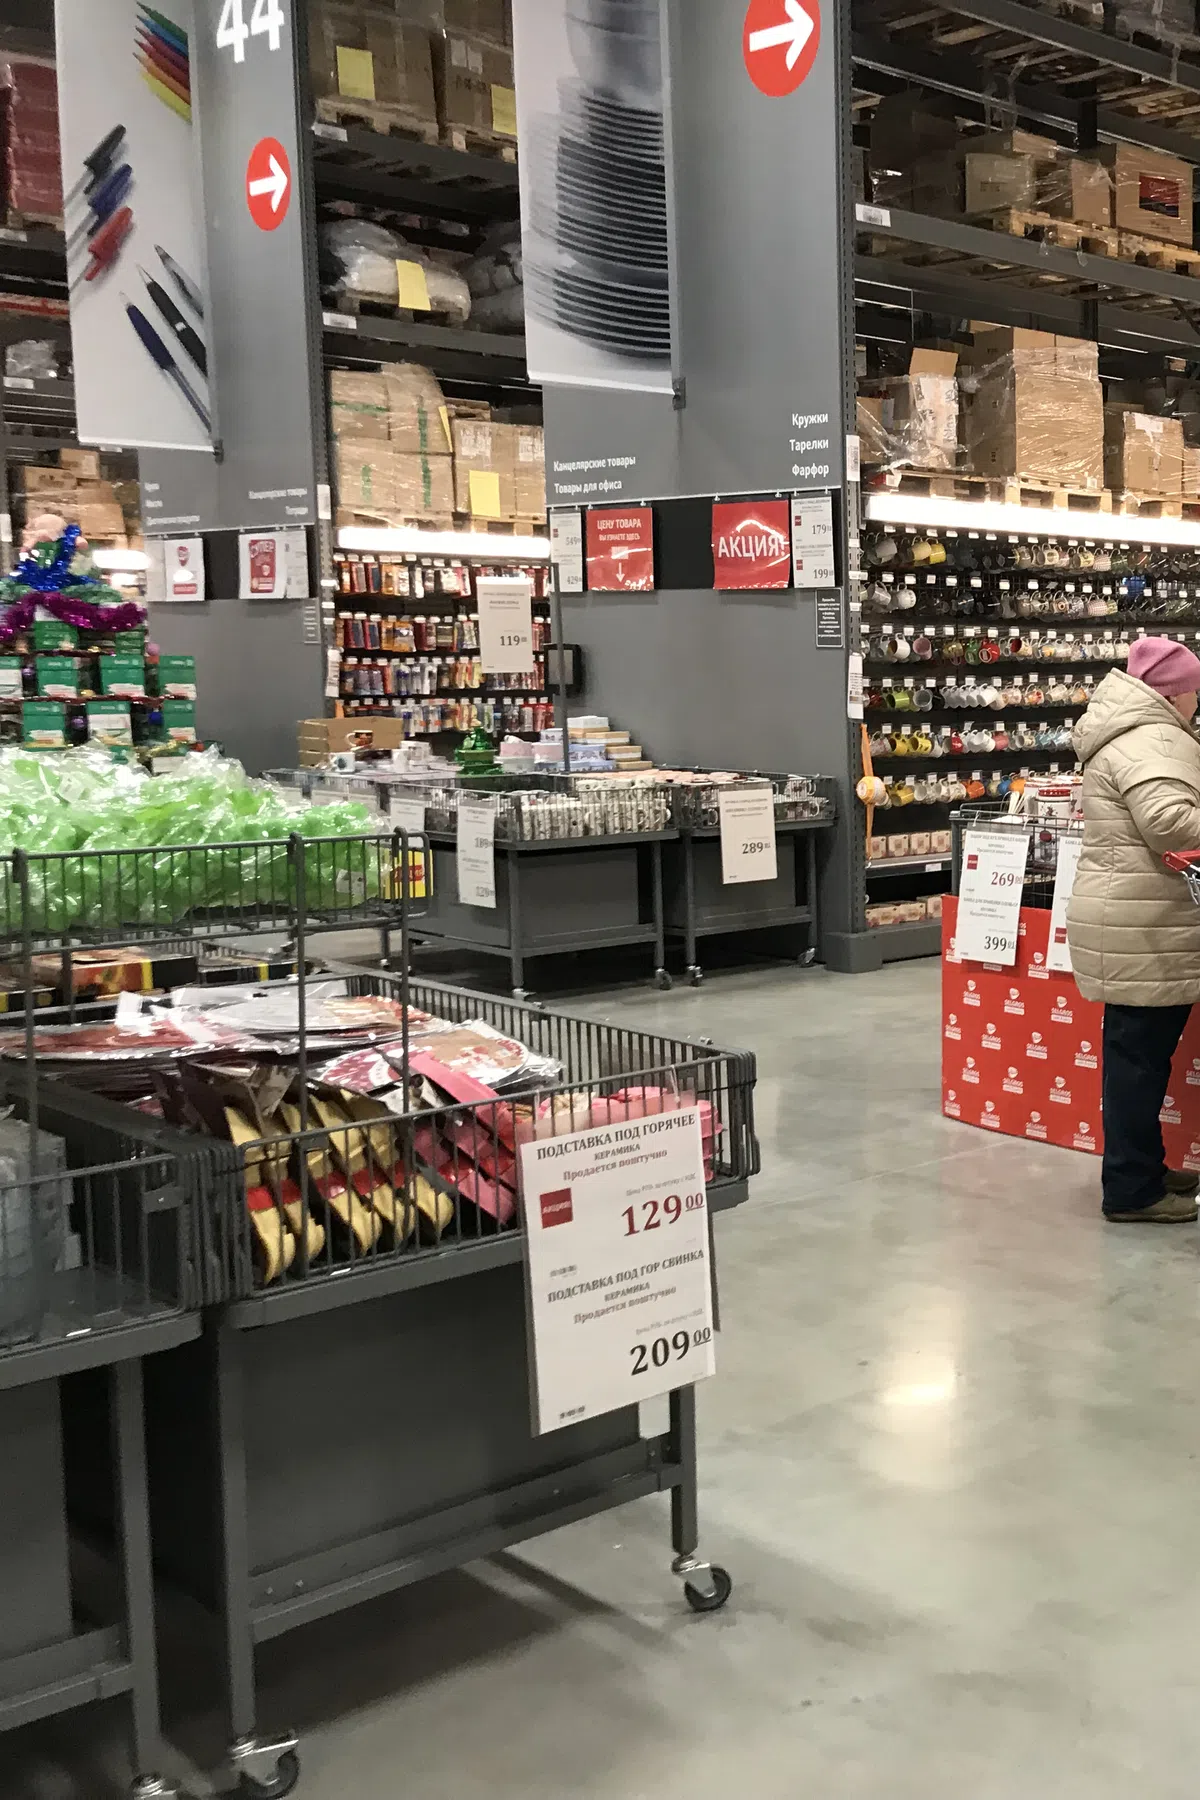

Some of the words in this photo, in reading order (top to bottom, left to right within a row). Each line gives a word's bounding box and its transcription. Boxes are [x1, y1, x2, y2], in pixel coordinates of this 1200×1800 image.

[216, 0, 284, 63] 44
[792, 413, 829, 429] Кружки
[789, 438, 829, 453] Тарелки
[553, 458, 606, 472] Канцелярские
[607, 456, 636, 469] товары
[792, 463, 829, 478] Фарфор
[554, 482, 582, 495] Товары
[583, 482, 598, 494] для
[598, 479, 622, 492] офиса
[597, 519, 615, 530] ЦЕНУ
[616, 518, 641, 529] ТОВАРА
[811, 524, 827, 535] 179
[718, 536, 786, 562] АКЦИЯ!
[813, 569, 829, 579] 199
[500, 635, 520, 646] 119
[742, 842, 764, 854] 289
[991, 871, 1015, 887] 269
[984, 935, 1007, 951] 399
[1160, 1107, 1181, 1117] ELGROS
[536, 1132, 612, 1160] ПОДСТАВКА
[614, 1126, 641, 1143] ПОД
[643, 1114, 696, 1136] ГОРЯЧЕЕ
[594, 1143, 641, 1161] КЕРАМИКА
[563, 1160, 618, 1182] Продается
[619, 1149, 668, 1168] поштучно
[621, 1195, 682, 1237] 129
[685, 1192, 705, 1212] 00
[548, 1277, 614, 1303] ПОДСТАВКА
[615, 1269, 639, 1286] ПОД
[640, 1261, 661, 1278] ГОР
[662, 1249, 705, 1269] СВИНКА
[604, 1282, 650, 1302] КЕРАМИКА
[573, 1303, 627, 1325] Продается
[628, 1286, 677, 1308] поштучно
[630, 1330, 690, 1376] 209
[693, 1327, 712, 1346] 00
